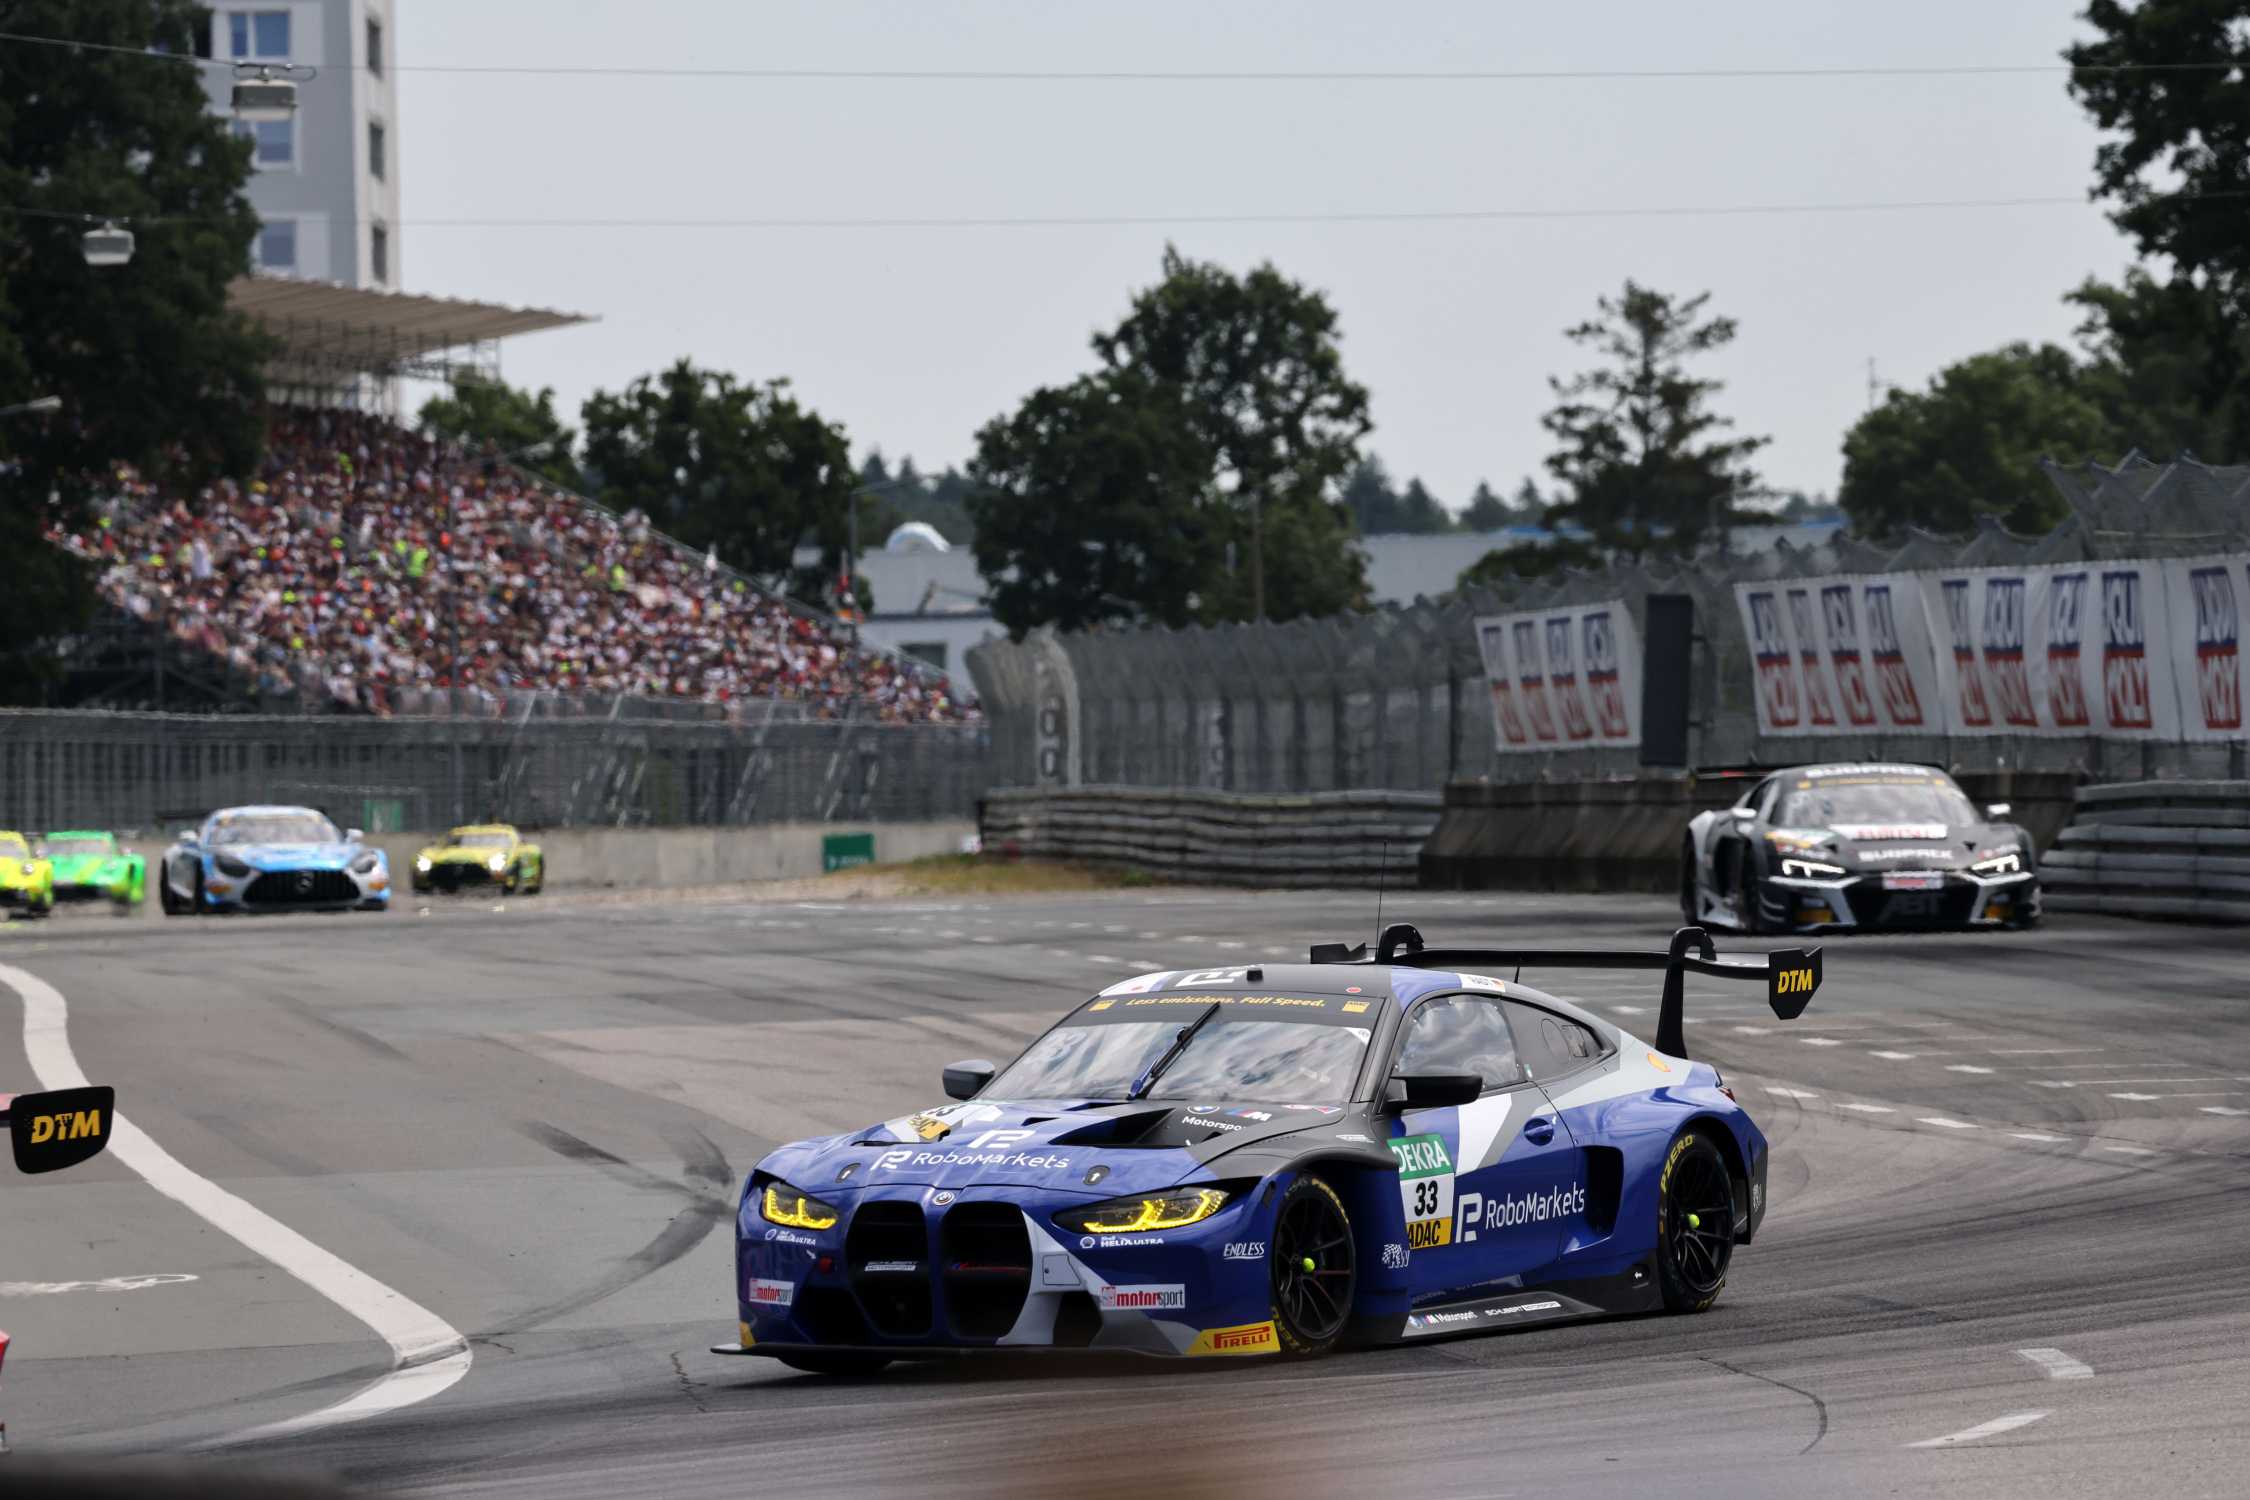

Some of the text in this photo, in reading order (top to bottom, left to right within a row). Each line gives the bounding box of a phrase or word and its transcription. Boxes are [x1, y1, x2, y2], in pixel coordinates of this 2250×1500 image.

[1777, 969, 1812, 993] DTM
[1240, 996, 1273, 1005] Full
[1273, 997, 1325, 1007] Speed.
[31, 1109, 101, 1144] DTM
[1182, 1115, 1243, 1131] Motorspo
[912, 1151, 1070, 1168] RoboMarkets
[1391, 1139, 1450, 1173] DEKRA
[1414, 1180, 1438, 1217] 33
[1486, 1181, 1585, 1230] RoboMarkets
[1134, 1237, 1164, 1245] ULTRA
[1407, 1219, 1440, 1248] ADAC
[1223, 1242, 1265, 1258] ENDLESS
[1116, 1289, 1184, 1308] motorsport
[1214, 1325, 1271, 1349] PIRELLI
